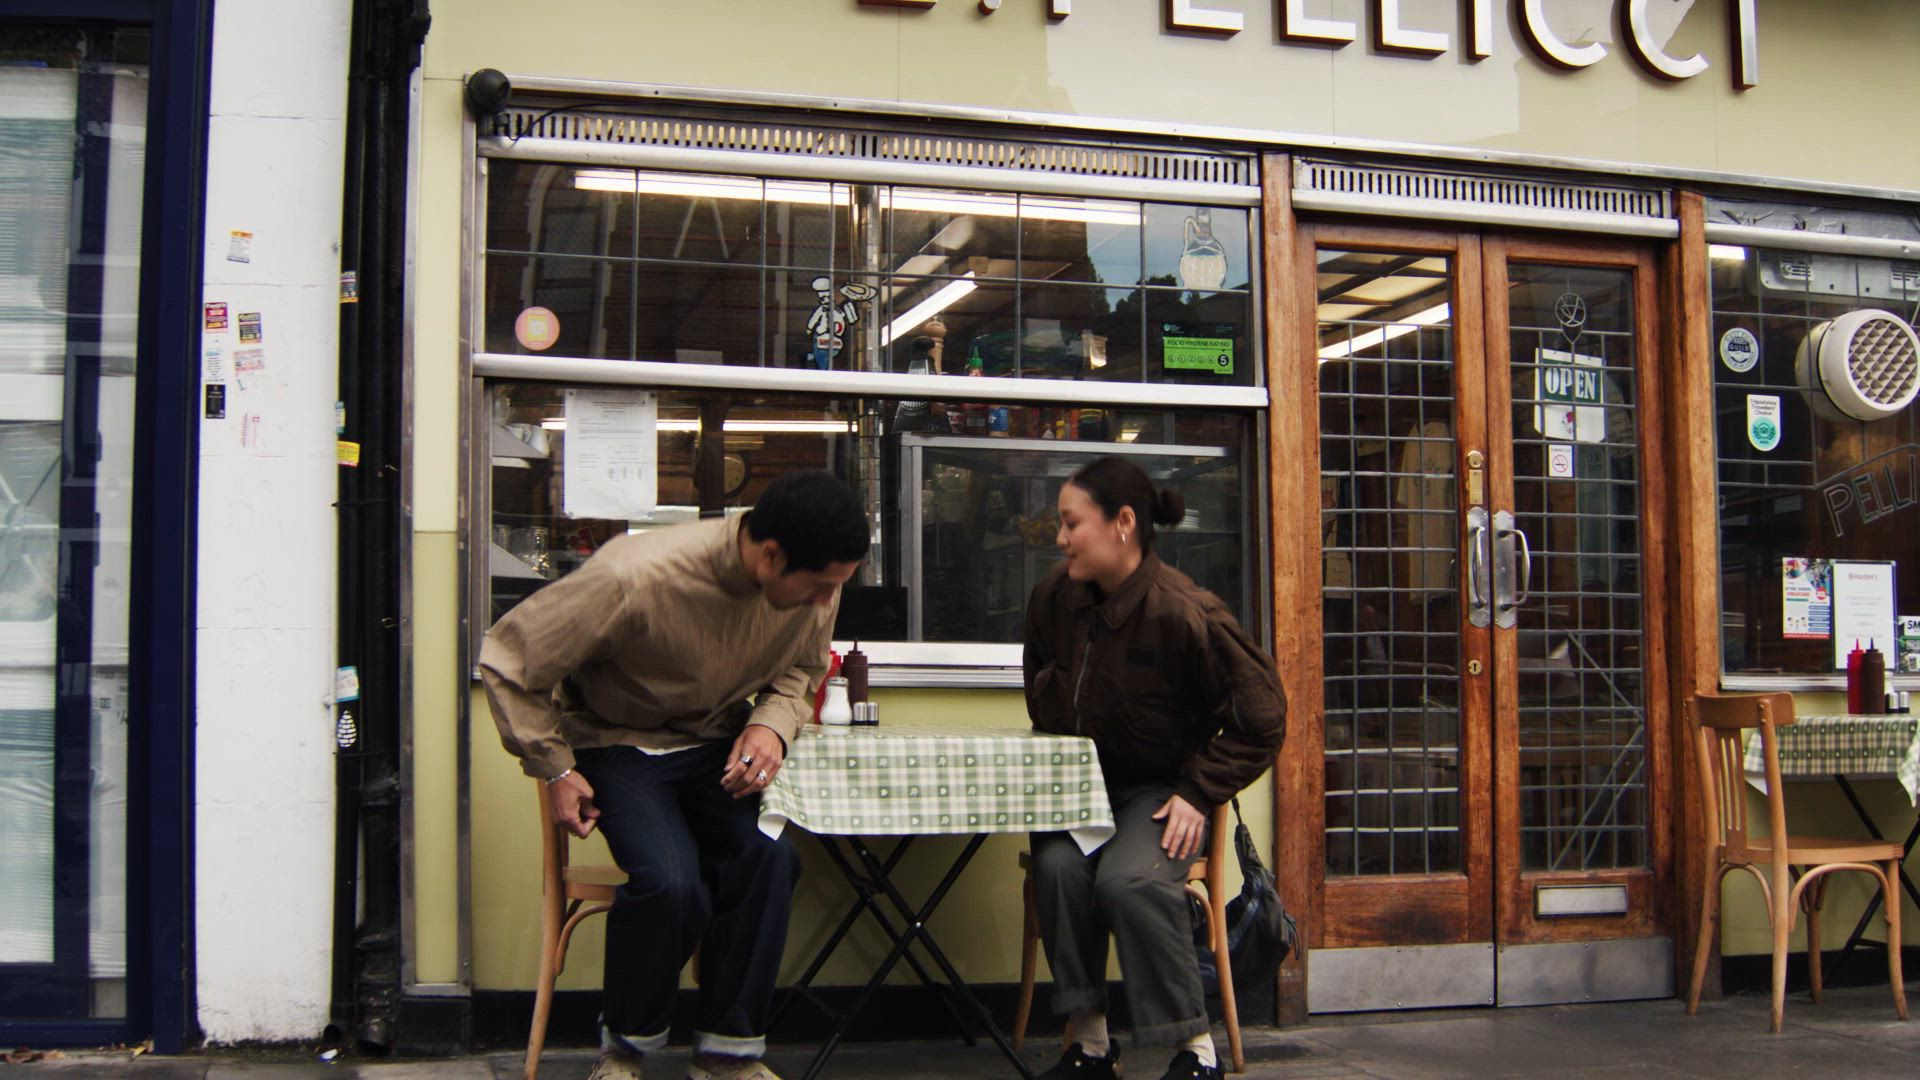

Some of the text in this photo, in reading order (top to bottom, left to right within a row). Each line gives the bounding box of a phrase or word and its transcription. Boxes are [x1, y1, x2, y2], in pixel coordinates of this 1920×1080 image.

[1047, 0, 1757, 89] LICCI
[1729, 343, 1750, 351] GUILD
[1545, 367, 1597, 400] OPEN
[1823, 454, 1918, 537] PELLI
[1907, 620, 1920, 630] SM
